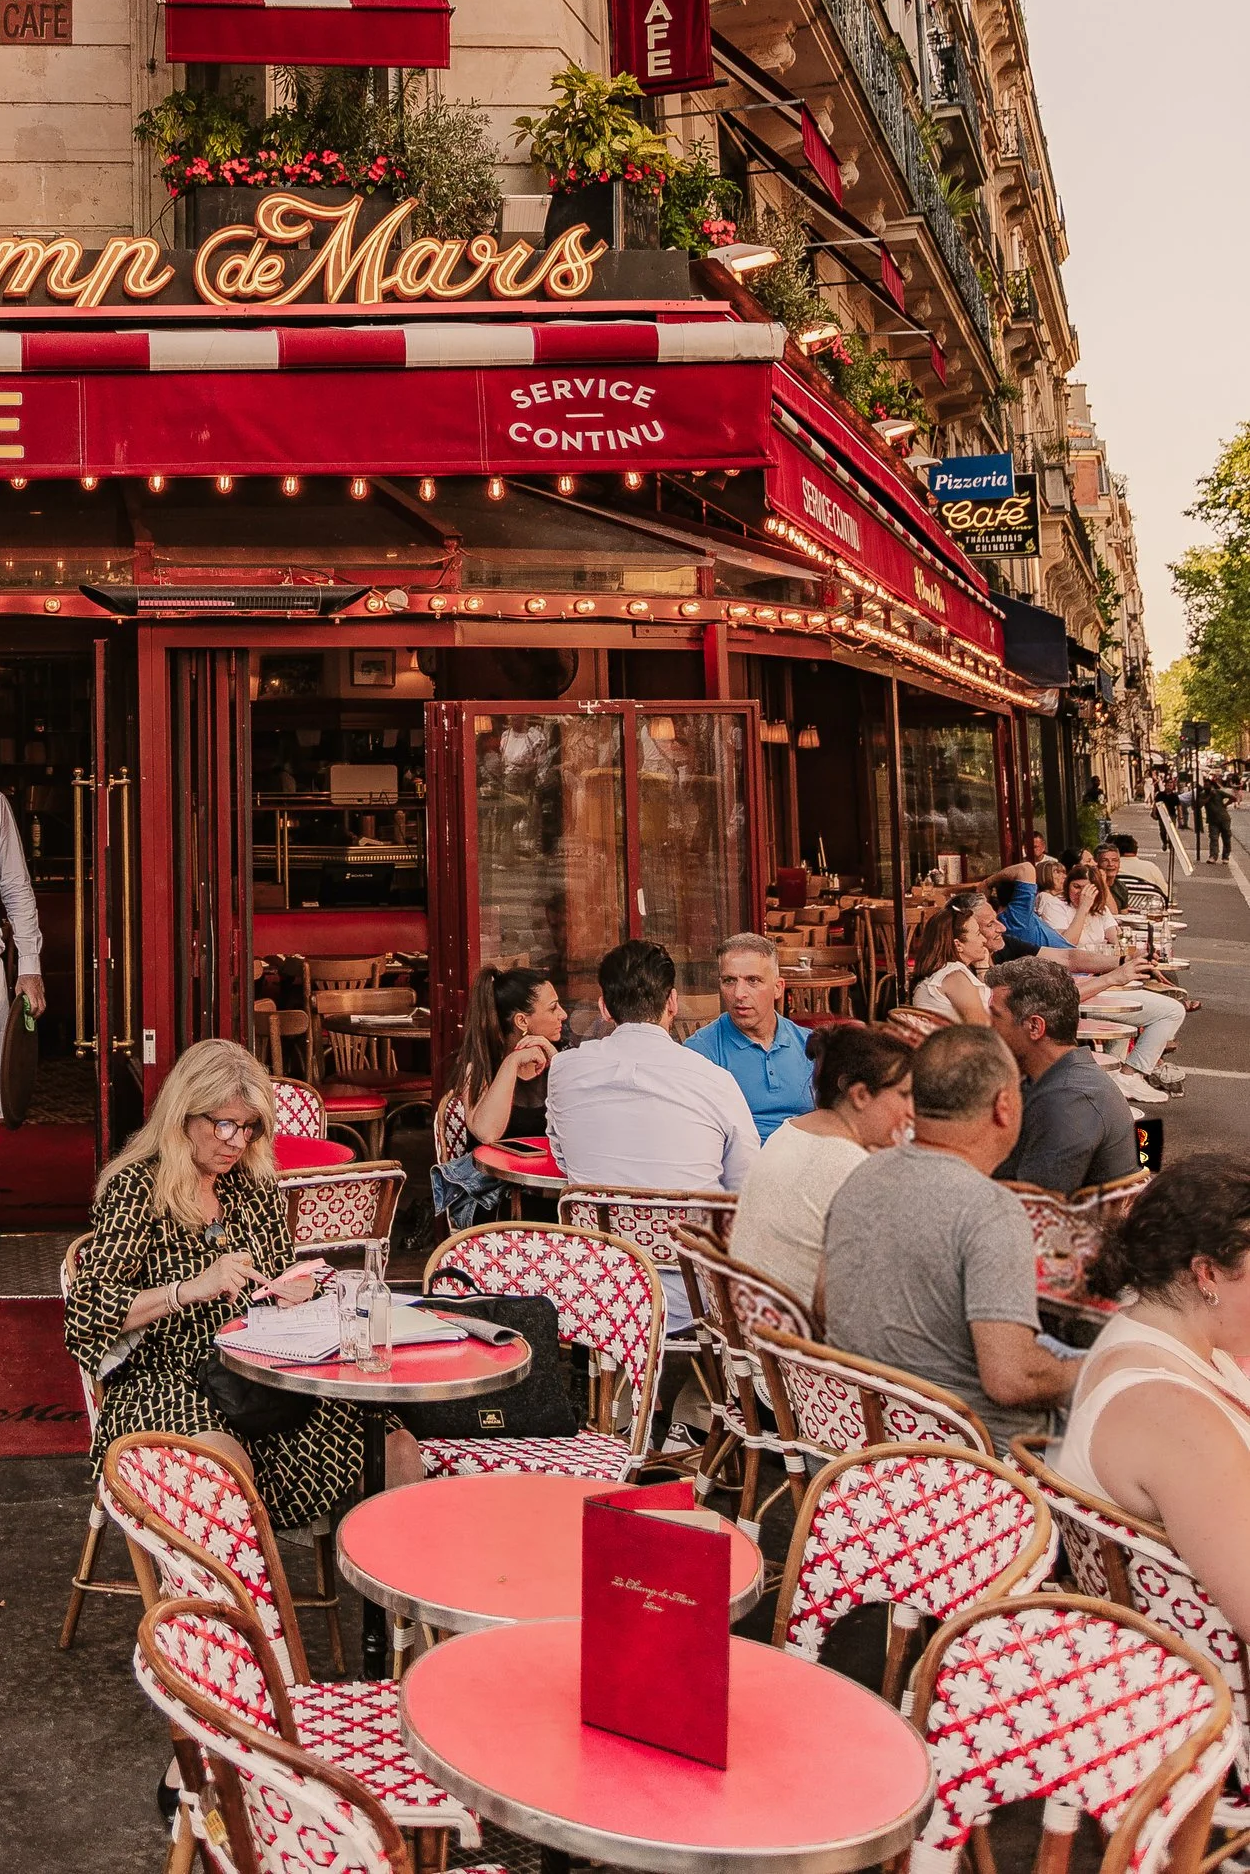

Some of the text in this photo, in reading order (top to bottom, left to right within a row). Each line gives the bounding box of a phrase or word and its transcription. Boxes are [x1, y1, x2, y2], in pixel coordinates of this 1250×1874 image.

[3, 2, 69, 38] CAFE
[196, 192, 609, 304] Mars
[210, 235, 289, 299] de
[510, 378, 656, 409] SERVICE
[508, 420, 665, 451] CONTINU
[934, 471, 1008, 491] Pizzeria
[975, 543, 1015, 552] CHINOIS
